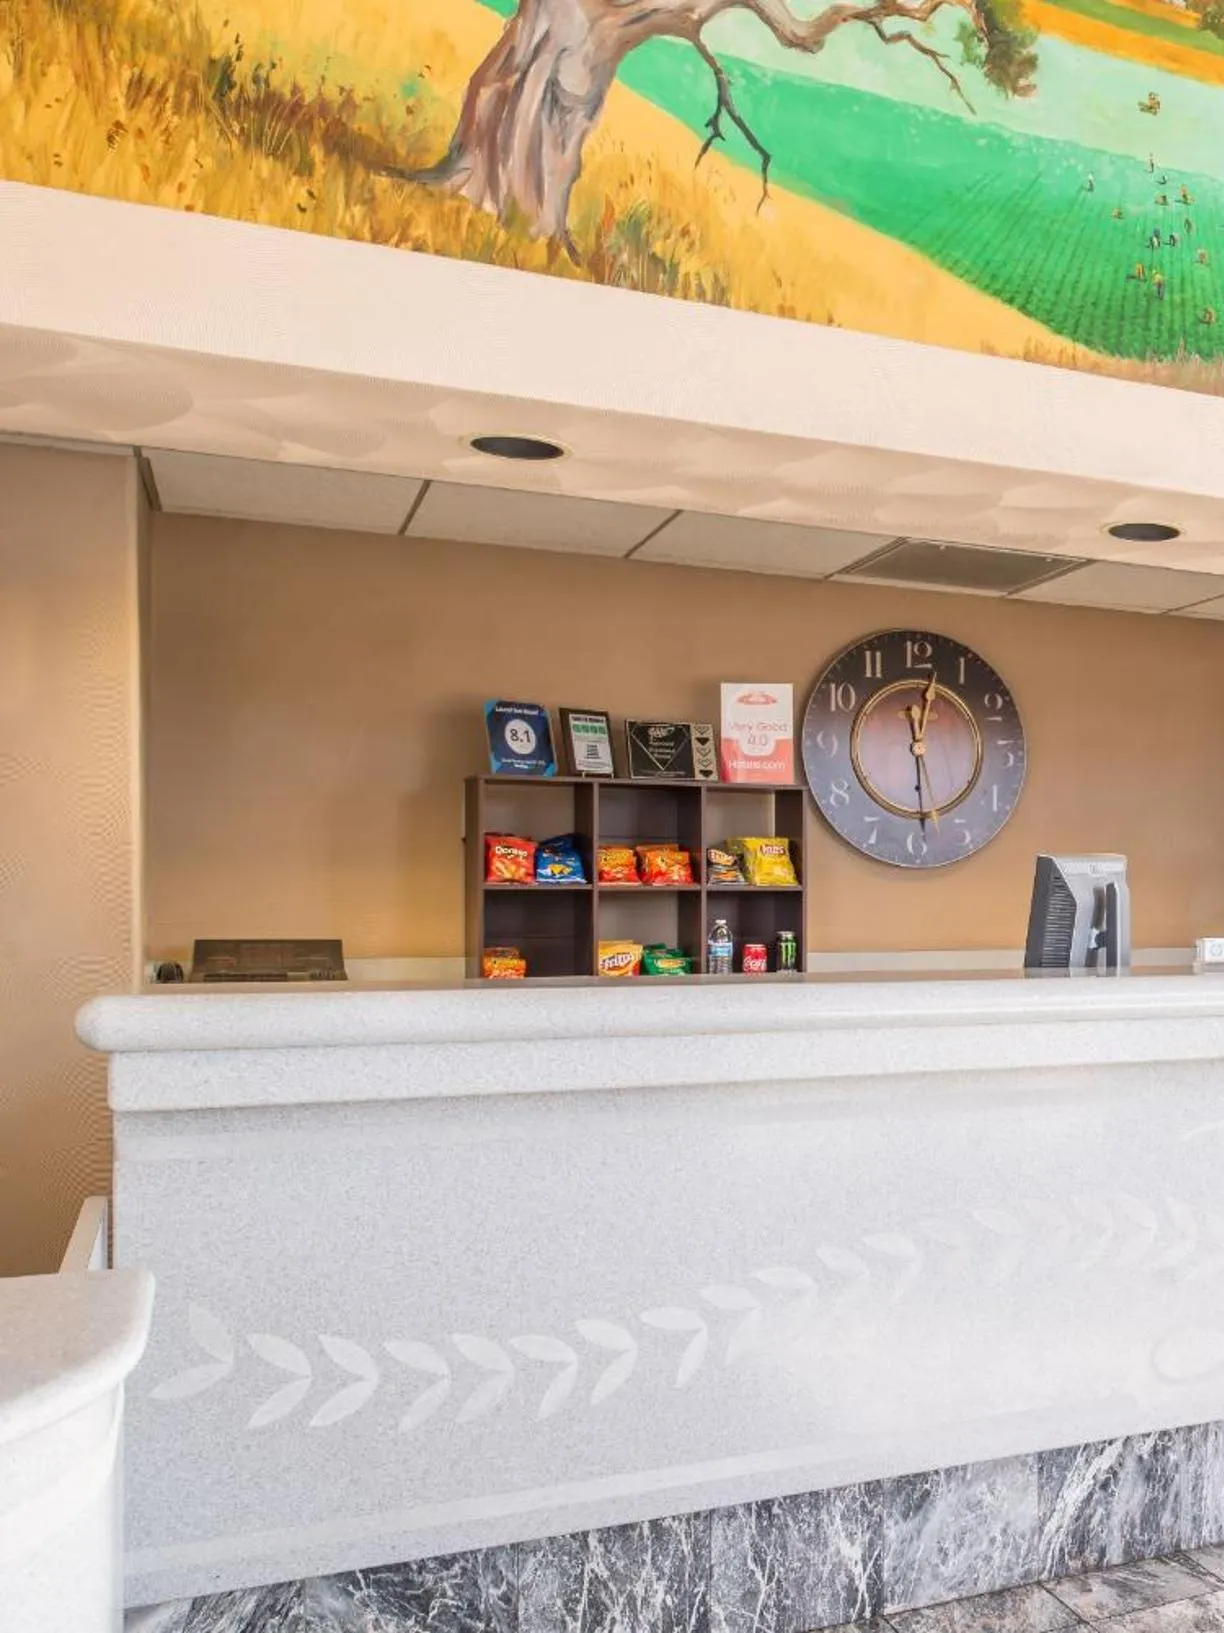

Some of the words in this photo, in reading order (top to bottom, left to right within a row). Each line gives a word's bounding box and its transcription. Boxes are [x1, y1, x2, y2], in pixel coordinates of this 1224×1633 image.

[865, 650, 882, 678] 11
[906, 640, 932, 668] 12
[959, 657, 965, 685] 1
[830, 682, 856, 713] 10
[510, 728, 531, 742] 8.1
[816, 730, 838, 757] 9
[830, 779, 850, 808] 8
[863, 816, 880, 845] 7
[906, 832, 928, 856] 6
